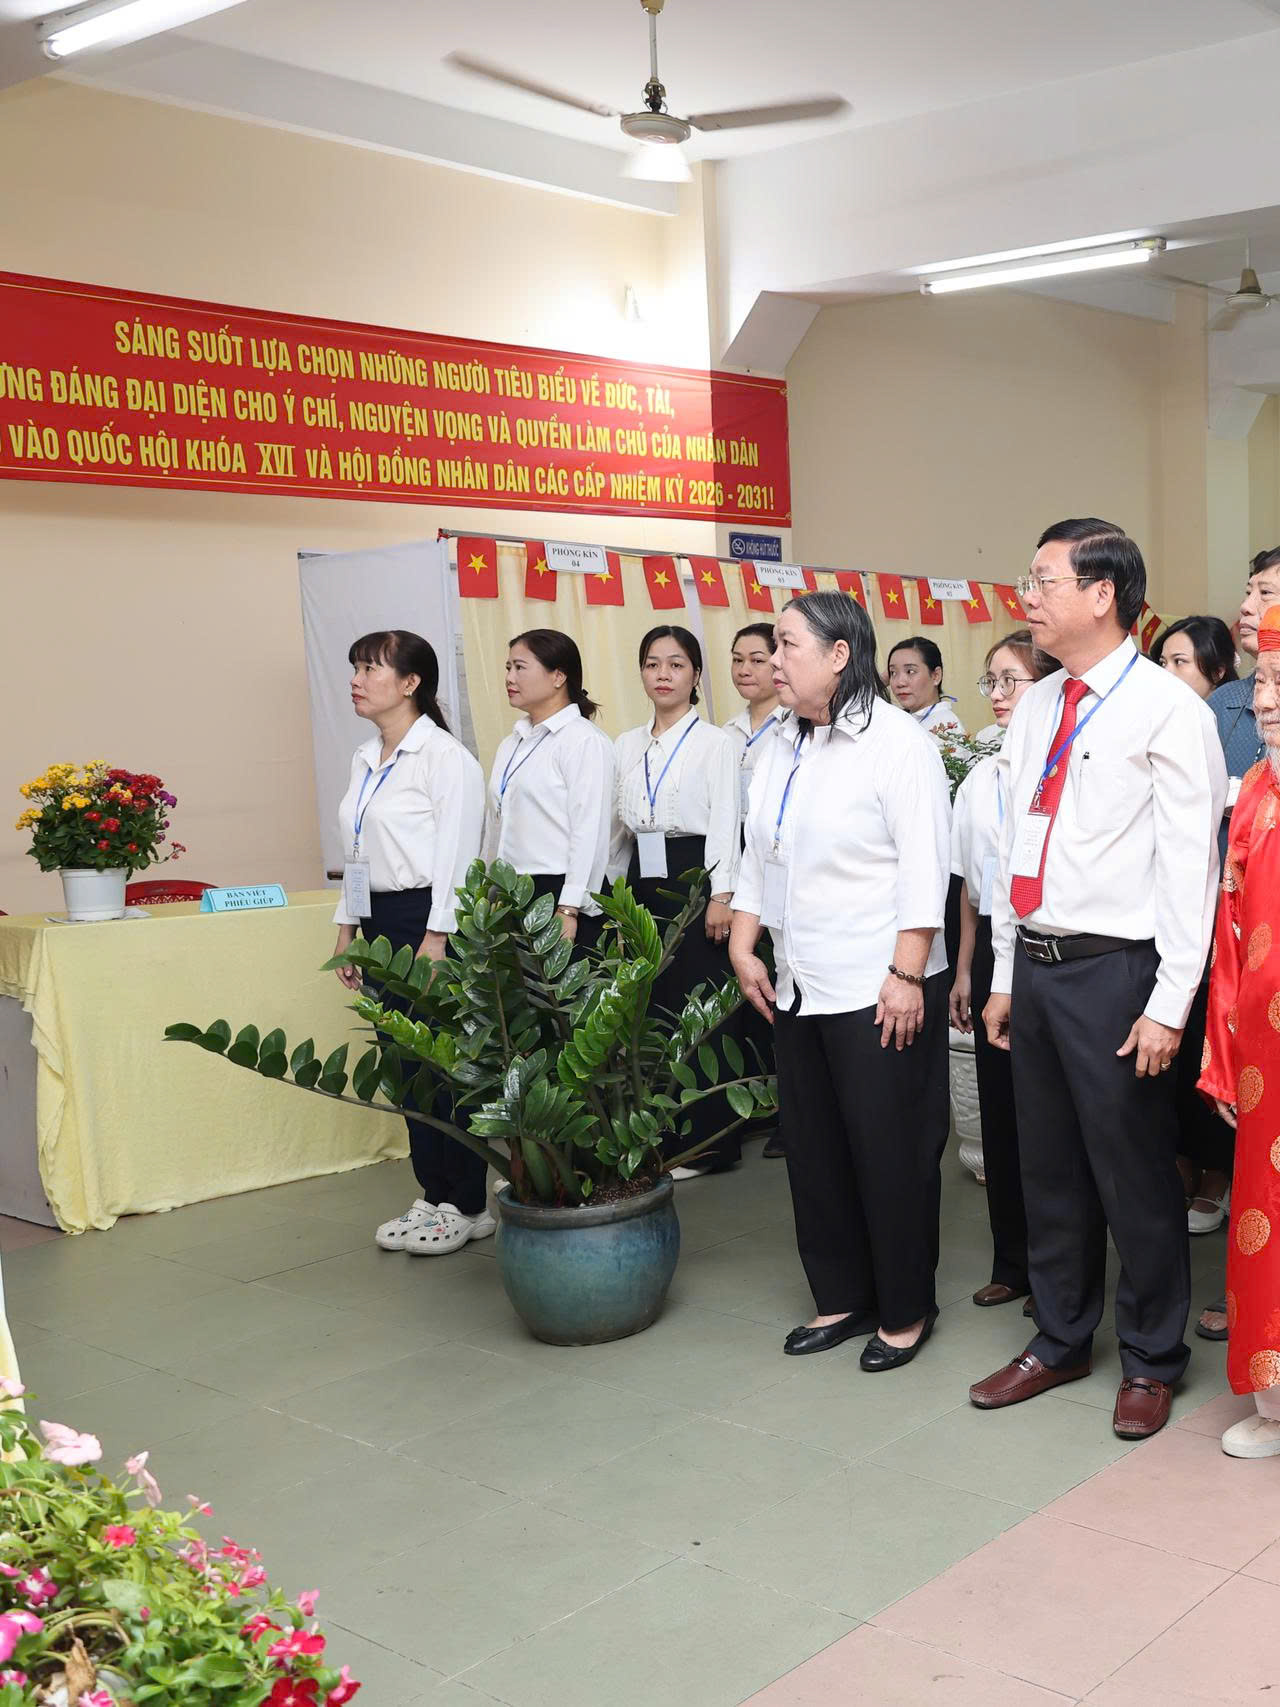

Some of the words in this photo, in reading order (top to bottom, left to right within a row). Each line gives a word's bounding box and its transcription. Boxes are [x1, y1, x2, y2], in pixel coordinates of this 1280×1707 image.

[49, 365, 120, 409] ĐÁNG
[125, 377, 167, 420] ĐẠI
[172, 378, 228, 424] DIỆN
[232, 389, 278, 424] CHO
[282, 388, 296, 425] Ý
[302, 393, 345, 433] CHÍ,
[349, 400, 429, 442] NGUYỆN
[432, 409, 484, 446] VỌNG
[486, 410, 512, 445] VÀ
[515, 412, 572, 449] QUYỀN
[575, 419, 612, 454] LÀM
[615, 421, 648, 457] CHỦ
[651, 424, 683, 460] CỦA
[685, 431, 727, 464] NHÂN
[729, 436, 759, 468] DÂN
[114, 316, 181, 359] SÁNG
[186, 323, 244, 367] SUỐT
[249, 337, 292, 377] LỰA
[298, 343, 355, 384] CHỌN
[359, 349, 429, 388] NHỮNG
[432, 358, 491, 394] NGƯỜI
[493, 364, 534, 400] TIÊU
[537, 365, 577, 405] BIỂU
[580, 372, 601, 407] VỀ
[604, 378, 643, 415] ĐỨC,
[645, 383, 676, 419] TÀI,
[8, 418, 61, 461] VÀO
[66, 420, 134, 466] QUỐC
[139, 429, 180, 475] HỘI
[185, 434, 248, 474] KHÓA
[254, 442, 298, 478] XVI
[305, 443, 334, 480] VÀ
[338, 446, 373, 488] HỘI
[377, 445, 432, 486] ĐỒNG
[436, 455, 489, 491] NHÂN
[493, 458, 531, 493] DÂN
[534, 462, 569, 496] CÁC
[573, 461, 606, 498] CẤP
[609, 469, 662, 507] NHIỆM
[665, 472, 684, 504] KỲ
[688, 479, 725, 507] 2026
[727, 492, 734, 500] -
[736, 483, 775, 511] 2031!
